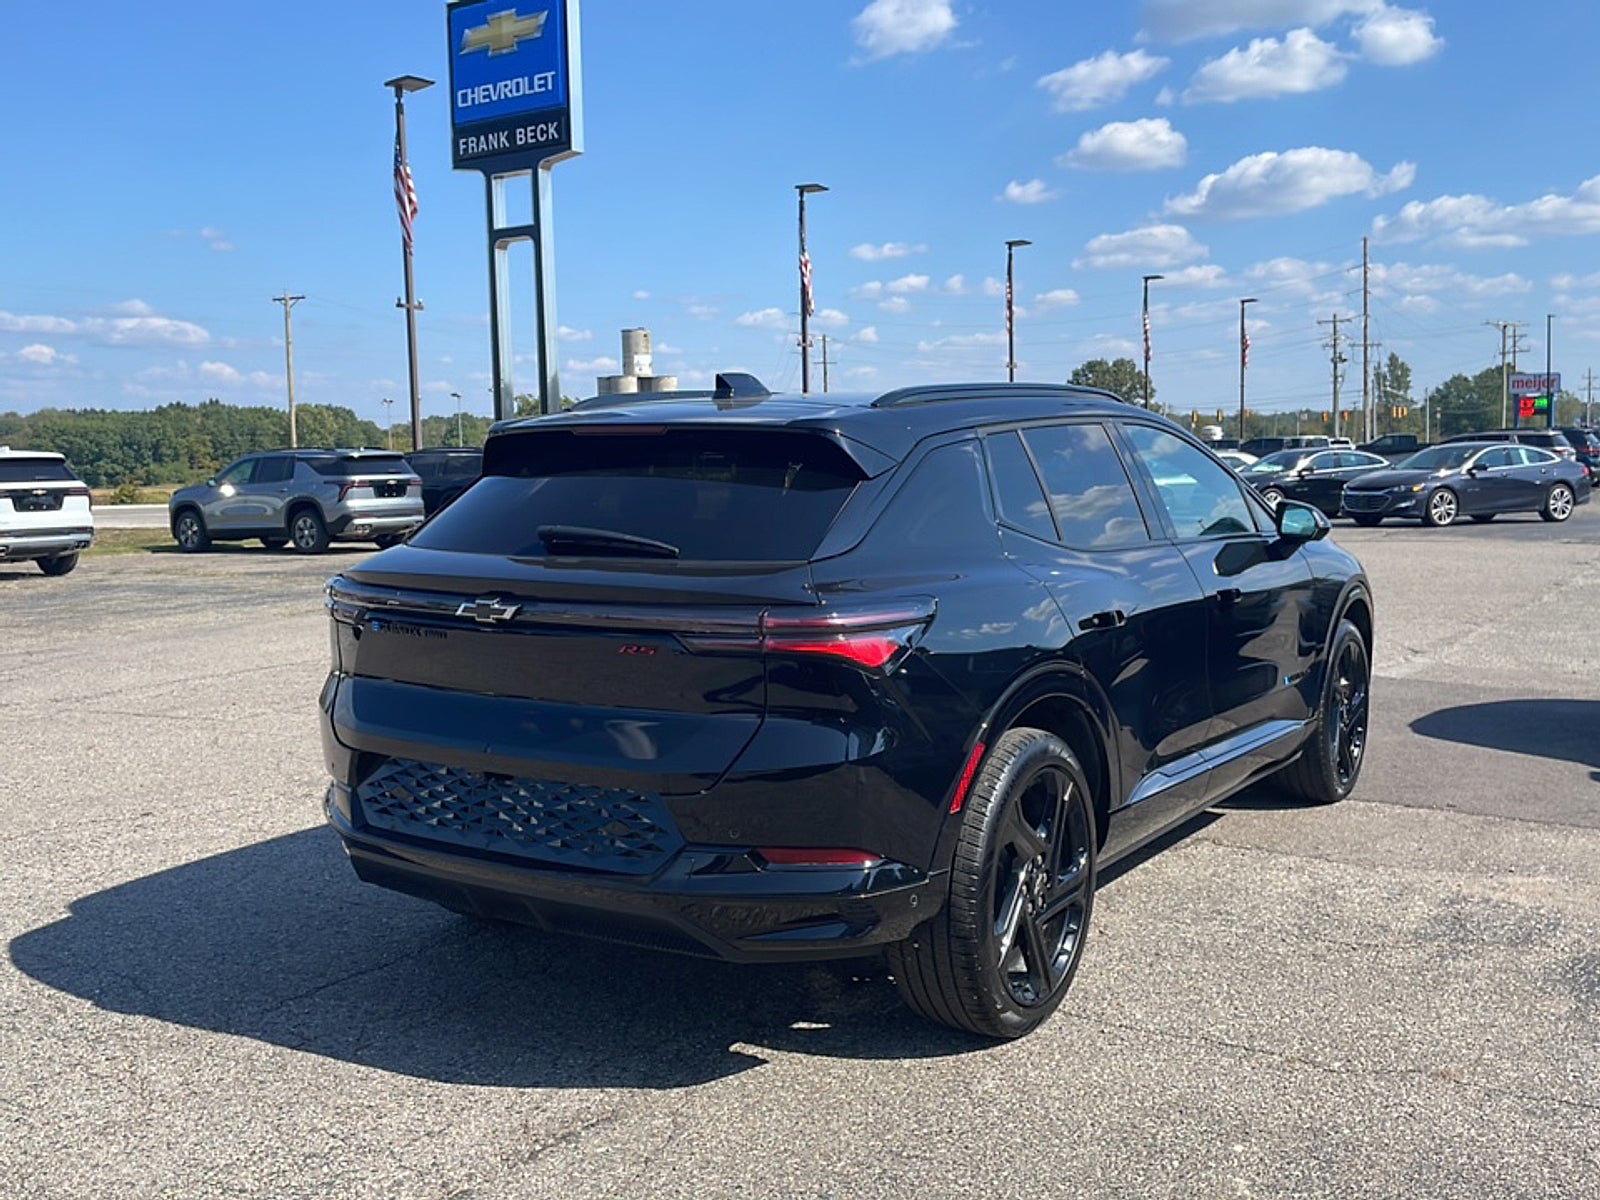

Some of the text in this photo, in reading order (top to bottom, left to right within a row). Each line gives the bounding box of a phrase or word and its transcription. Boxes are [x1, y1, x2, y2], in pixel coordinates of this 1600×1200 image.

[457, 71, 555, 108] CHEVROLET
[459, 122, 559, 155] FRANK BECK
[1511, 375, 1557, 392] meijer
[618, 645, 656, 656] RS
